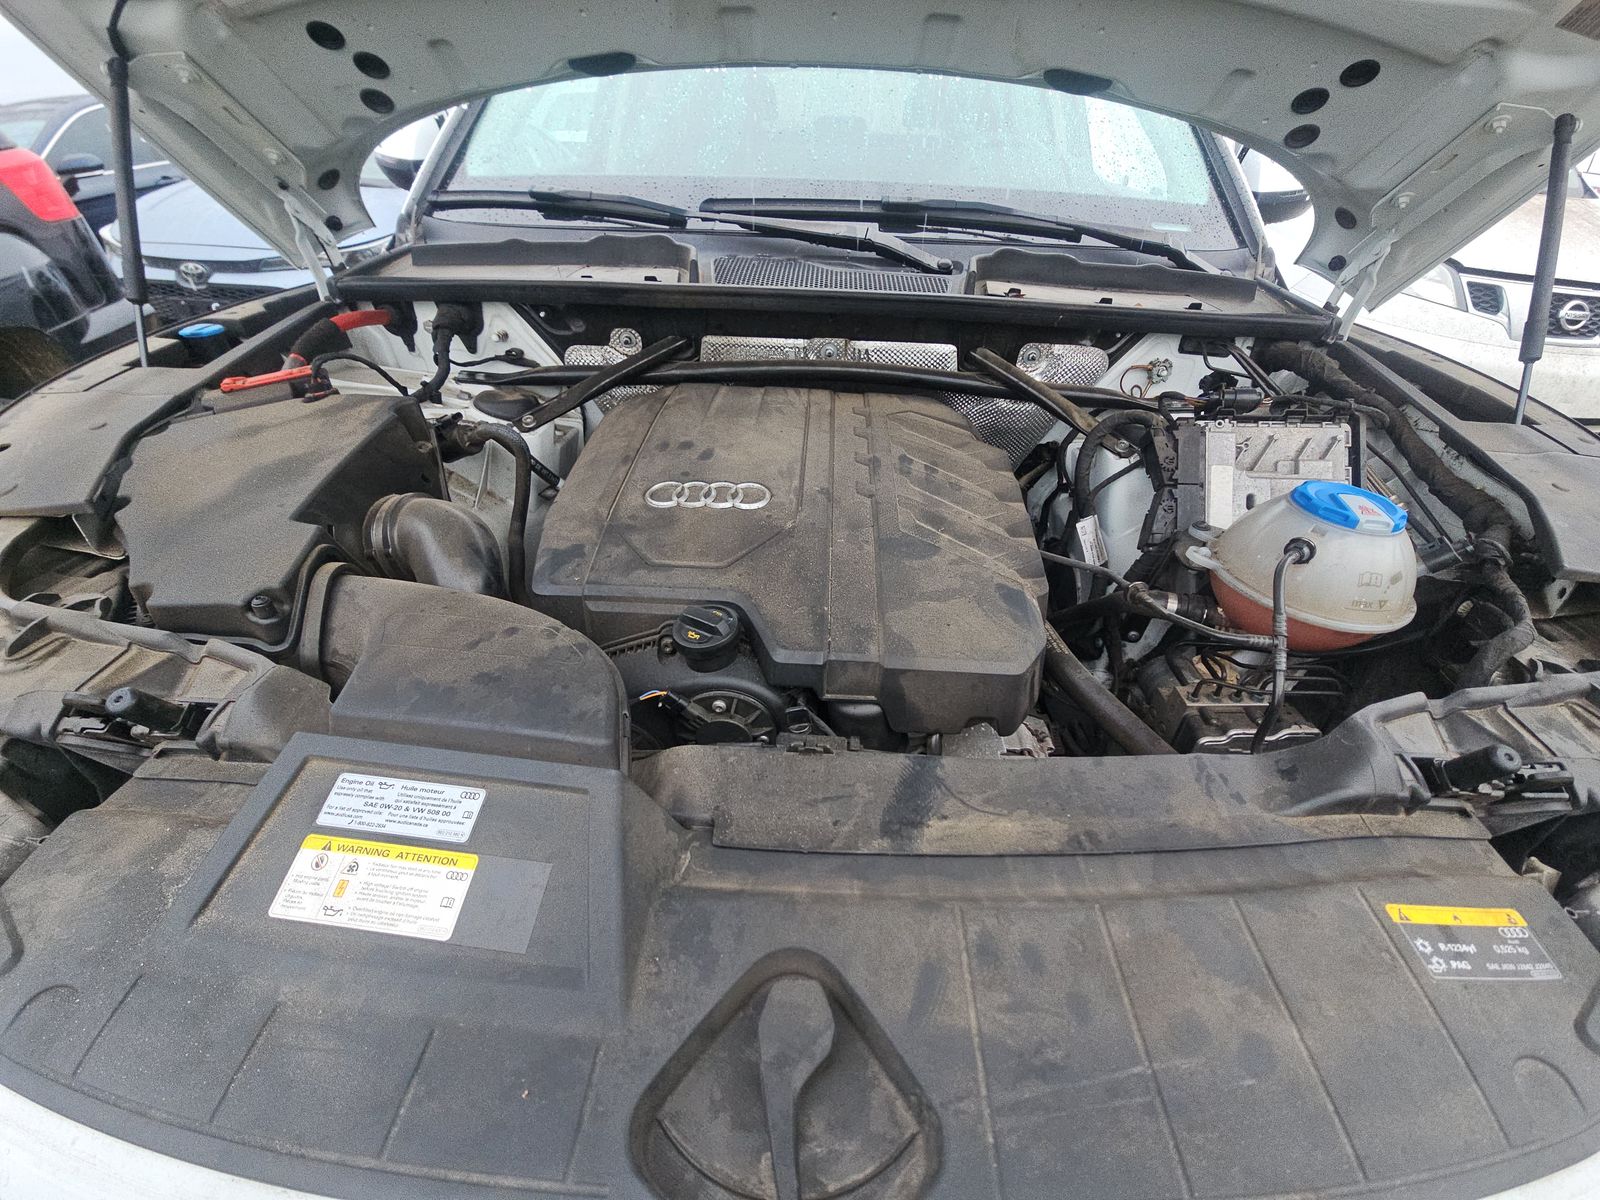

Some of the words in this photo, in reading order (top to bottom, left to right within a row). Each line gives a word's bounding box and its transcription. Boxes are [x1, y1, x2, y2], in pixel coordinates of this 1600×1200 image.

[380, 803, 403, 811] 0W-20
[427, 808, 440, 816] 508
[337, 844, 390, 857] WARNING
[395, 852, 458, 866] ATTENTION
[1516, 946, 1530, 955] kg
